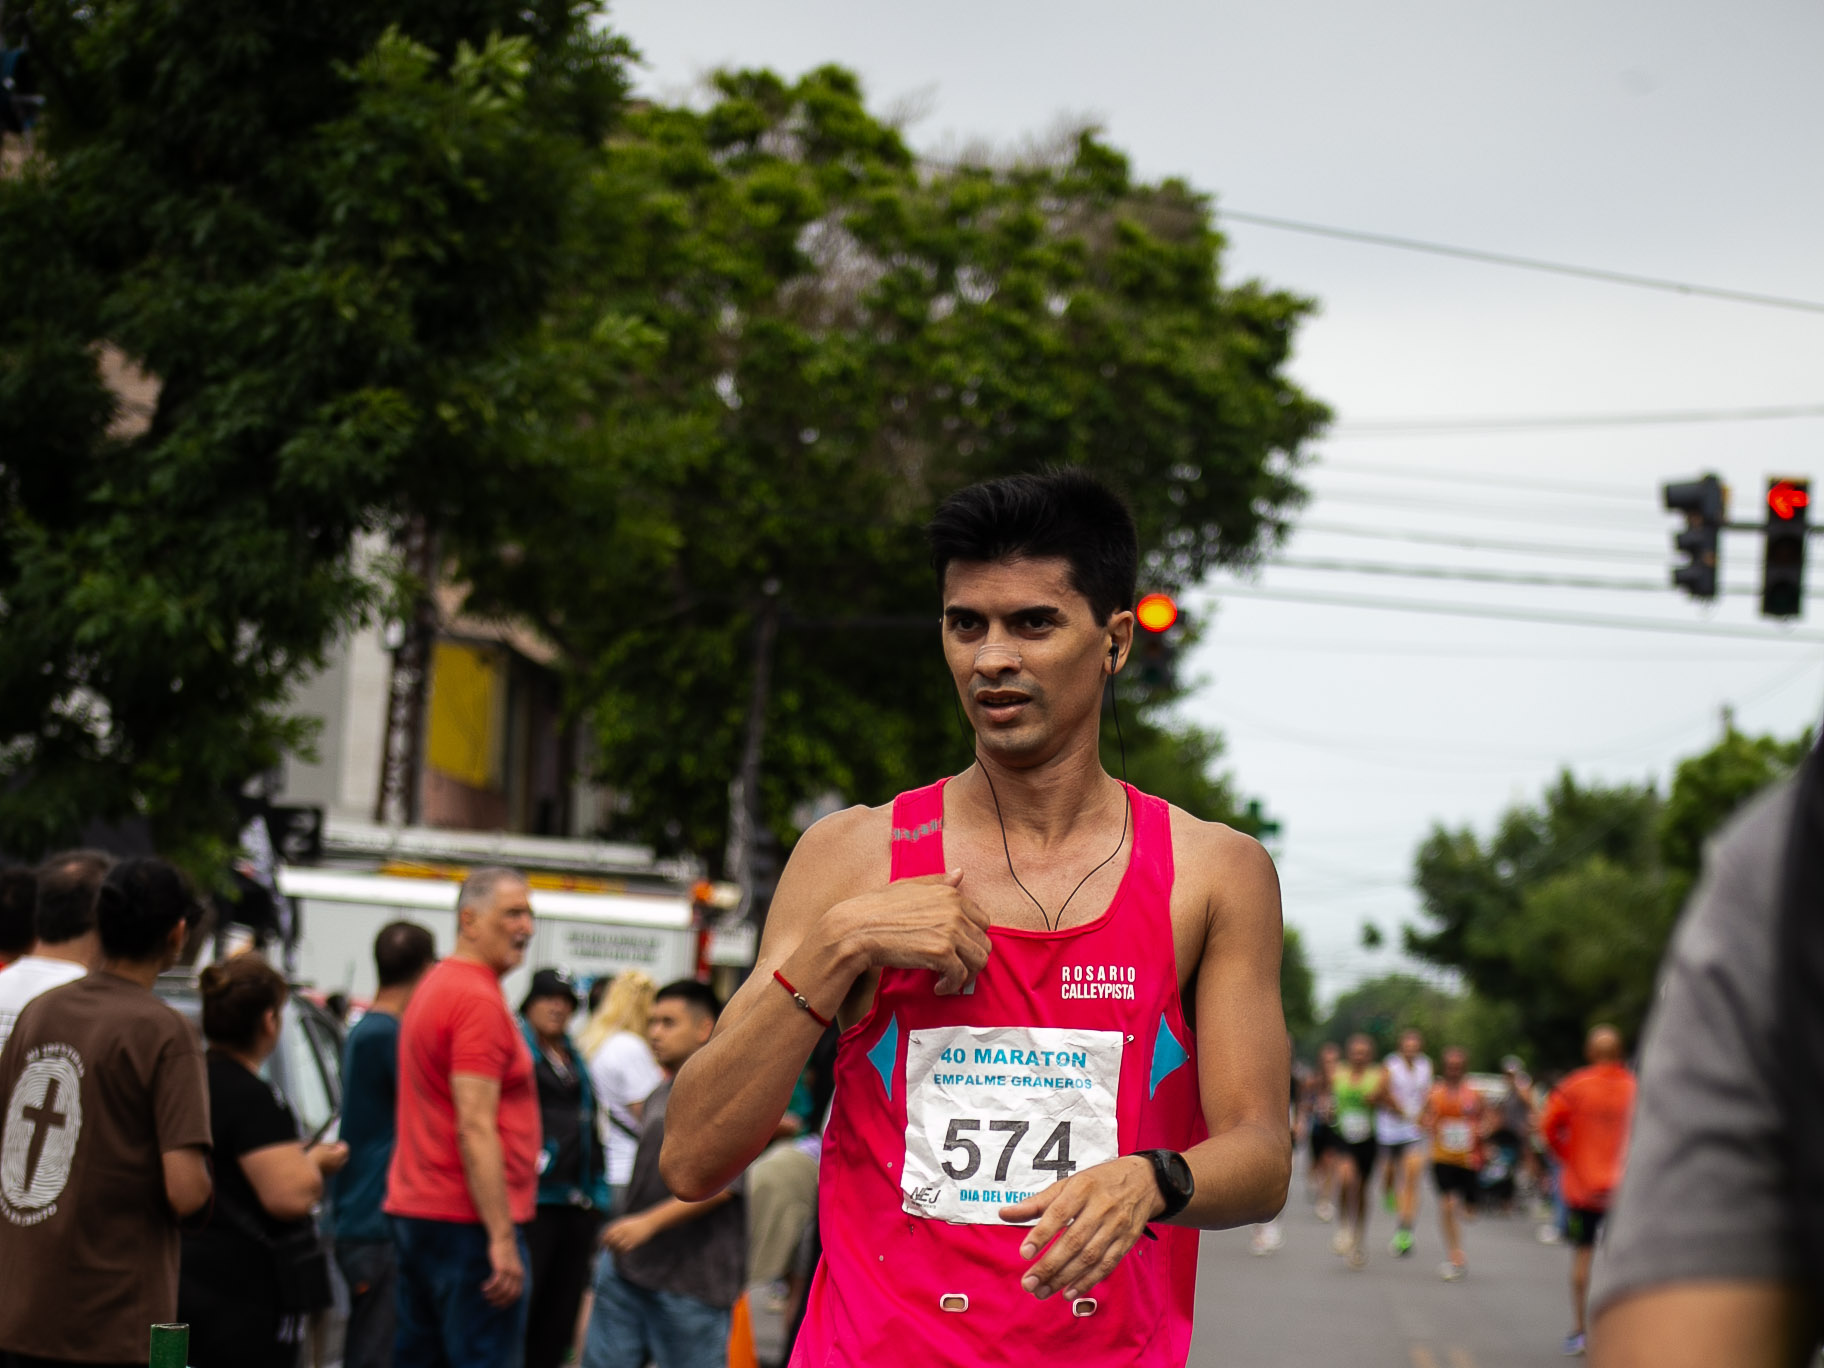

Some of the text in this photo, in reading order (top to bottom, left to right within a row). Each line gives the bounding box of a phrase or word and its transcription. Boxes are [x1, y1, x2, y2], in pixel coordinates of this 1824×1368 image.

[1061, 965, 1136, 983] ROSARIO
[1061, 983, 1135, 1001] CALLEYPISTA
[940, 1047, 1088, 1069] 40 MARATON
[933, 1073, 1093, 1090] EMPALME GRANEROS
[940, 1118, 1077, 1183] 574
[959, 1189, 1038, 1204] DIA DEL VEC
